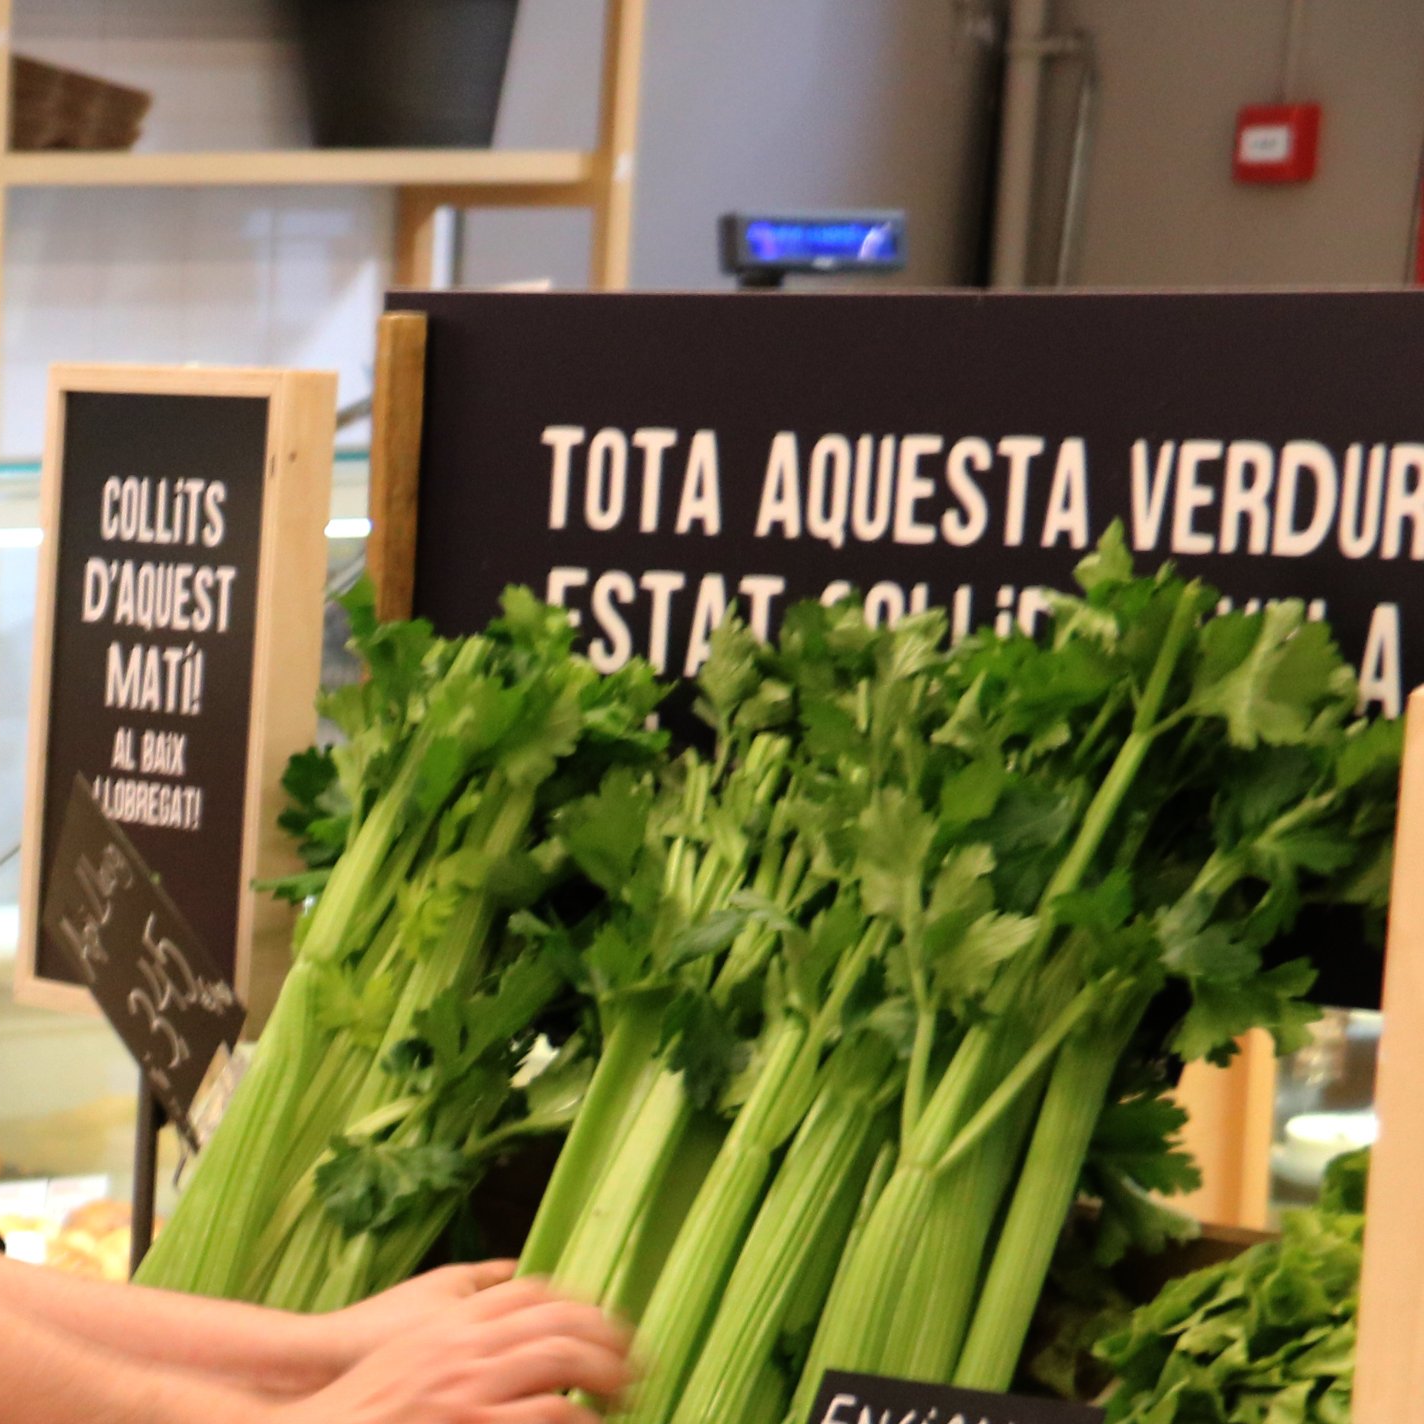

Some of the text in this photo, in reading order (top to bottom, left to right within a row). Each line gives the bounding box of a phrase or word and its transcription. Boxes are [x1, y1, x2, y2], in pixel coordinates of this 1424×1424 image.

[542, 424, 1424, 562] TOTA AQUESTA VERDUR
[82, 557, 235, 634] D'AQUEST
[111, 726, 136, 772] AL
